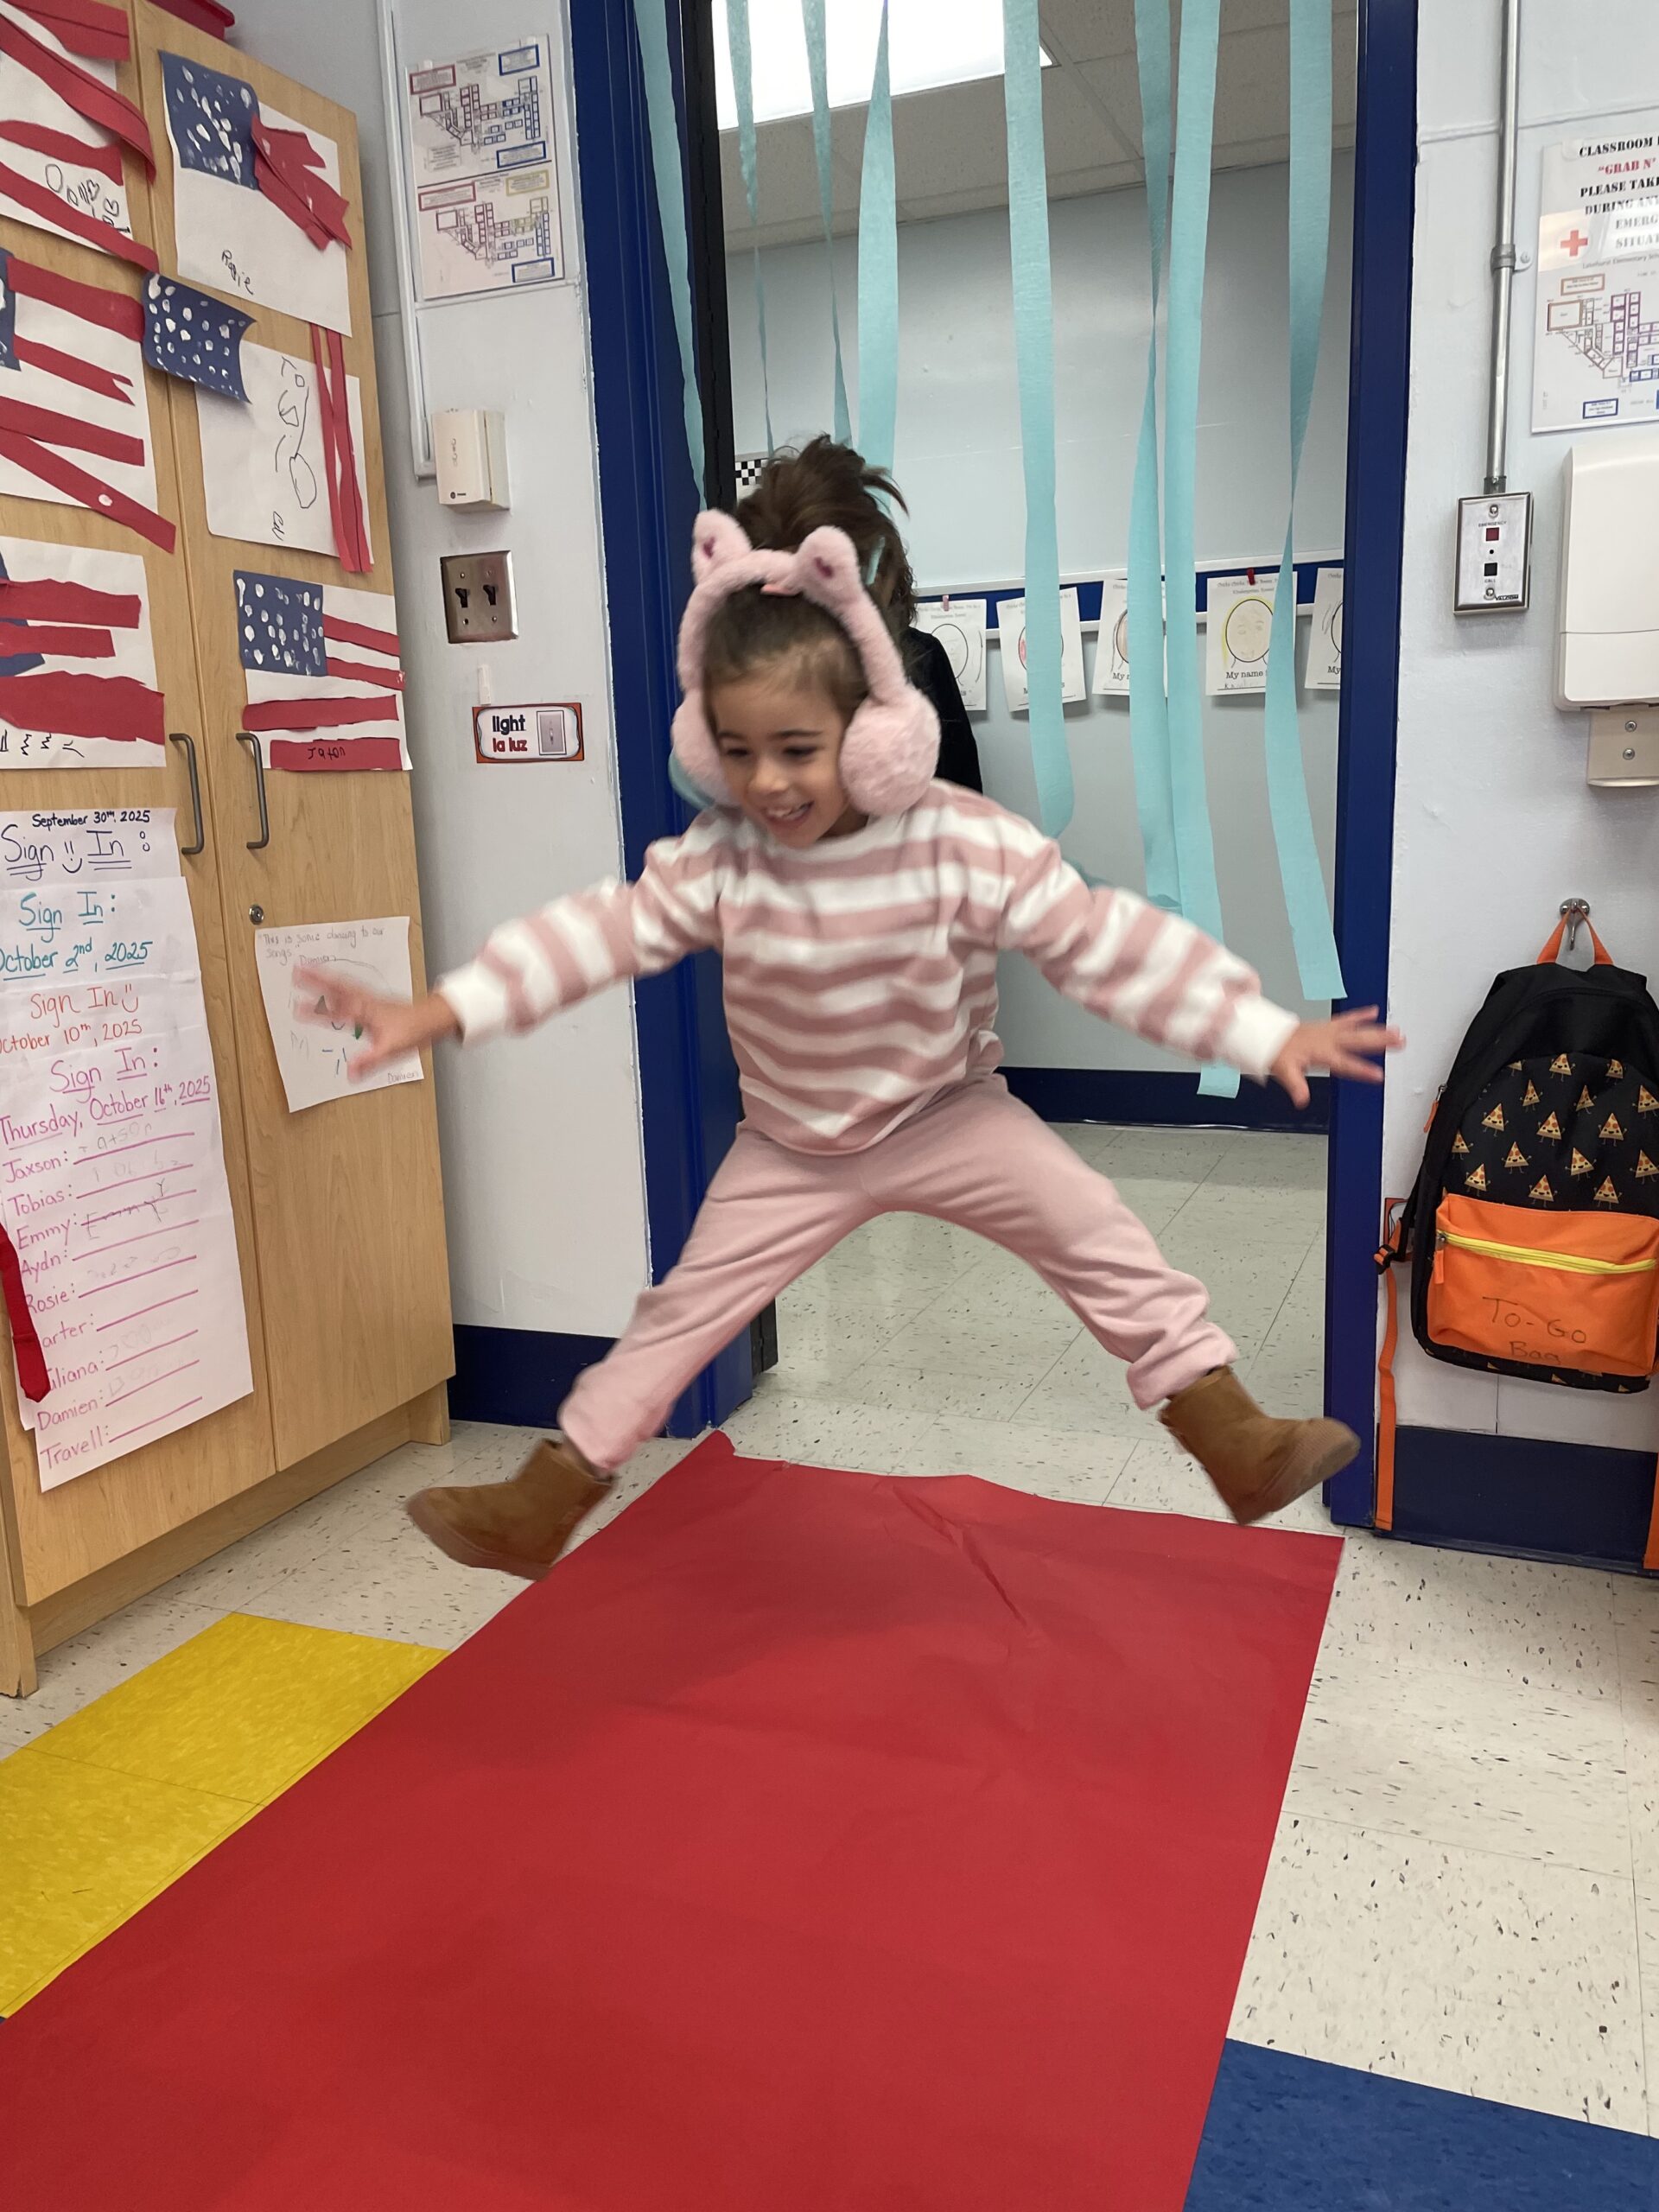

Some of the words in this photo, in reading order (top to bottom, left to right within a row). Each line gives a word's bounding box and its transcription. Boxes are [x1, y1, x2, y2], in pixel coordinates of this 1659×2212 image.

[1580, 137, 1653, 157] CLASSROOM
[1580, 181, 1626, 197] PLEASE
[1586, 199, 1633, 215] DURING
[1226, 671, 1239, 680] My
[493, 715, 525, 735] light
[493, 738, 505, 753] la
[509, 737, 528, 752] luz
[32, 813, 88, 831] September
[120, 810, 150, 823] 2025
[1, 824, 54, 880] Sign
[18, 892, 62, 943] Sign
[105, 940, 153, 962] 2025
[30, 993, 80, 1028] Sign
[86, 986, 118, 1008] In
[0, 1033, 50, 1053] ctober
[102, 1019, 143, 1040] 2025
[49, 1060, 102, 1103] Sign
[89, 1090, 149, 1121] October
[179, 1075, 210, 1100] 2025
[42, 1313, 93, 1348] arter:
[1510, 1341, 1560, 1366] Bag
